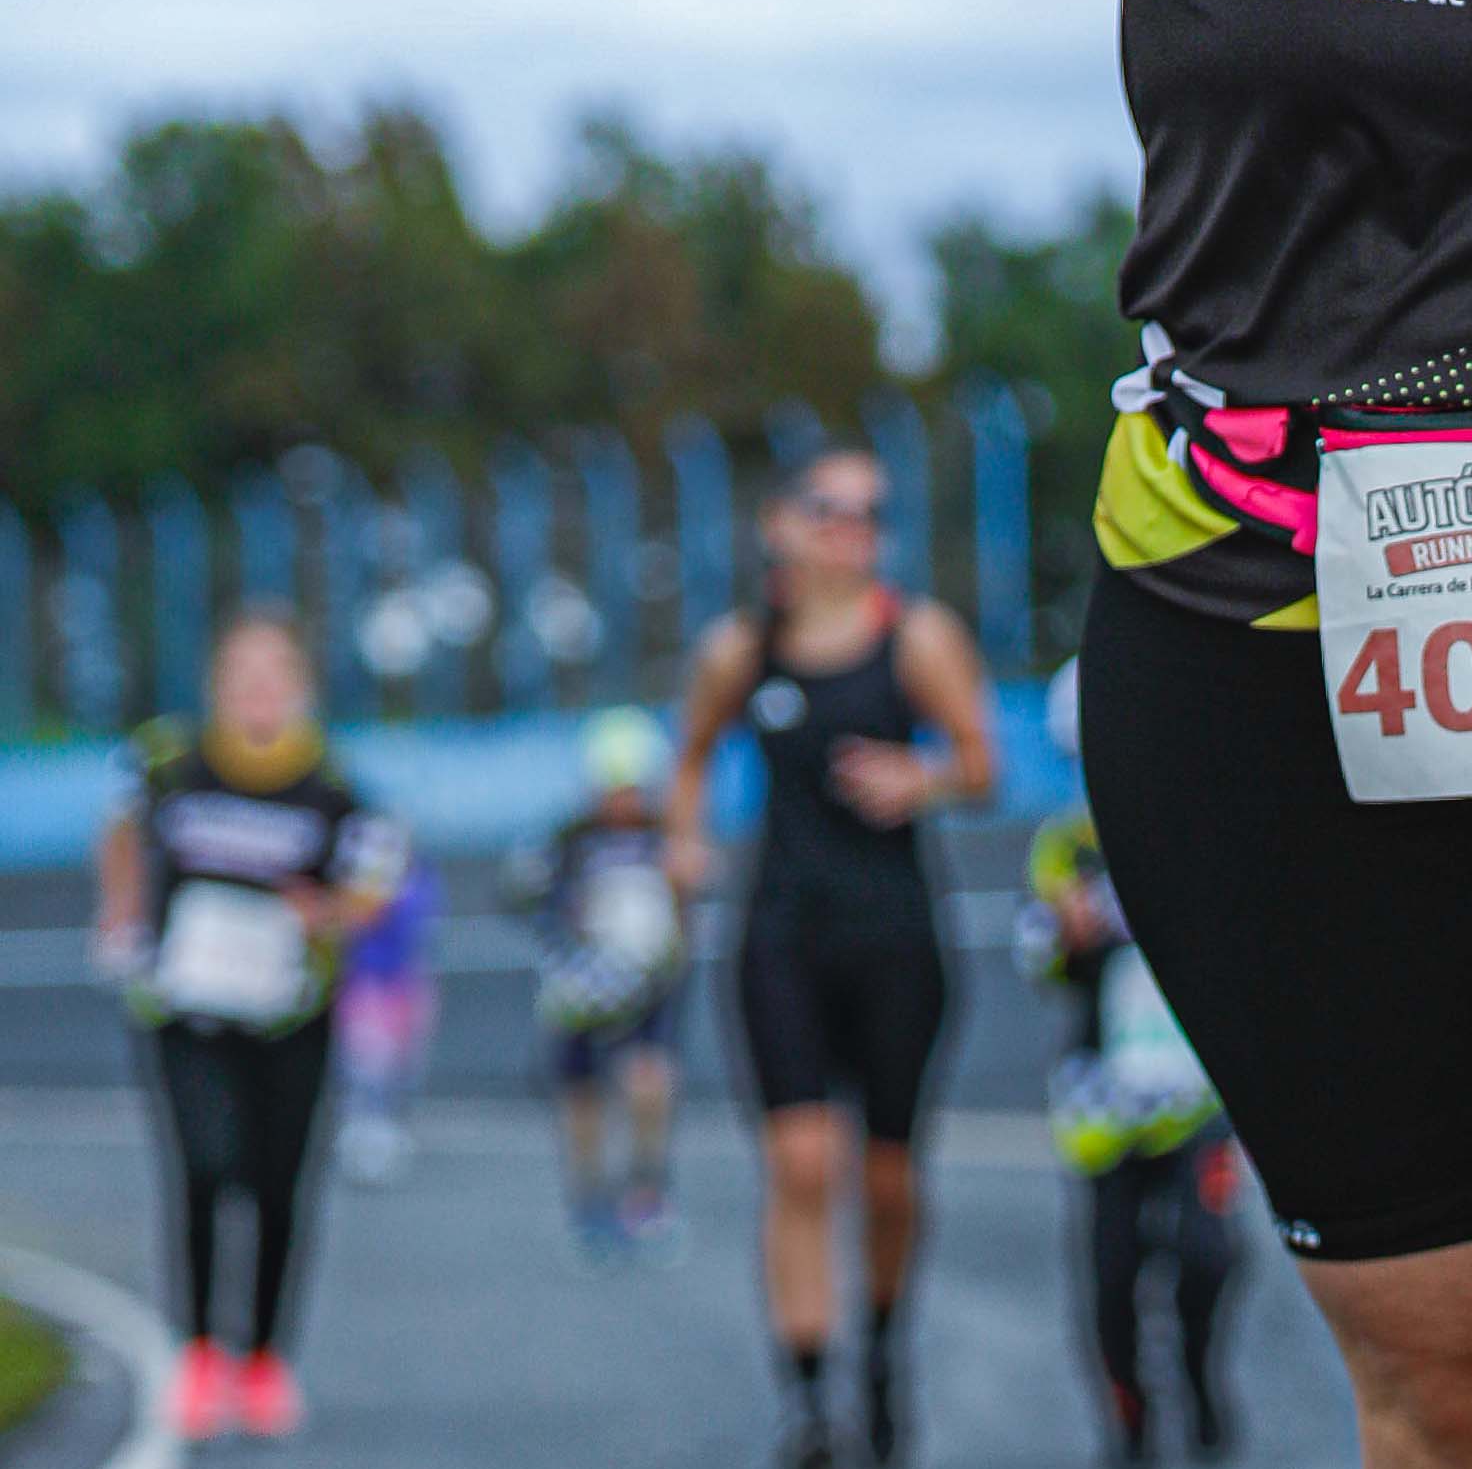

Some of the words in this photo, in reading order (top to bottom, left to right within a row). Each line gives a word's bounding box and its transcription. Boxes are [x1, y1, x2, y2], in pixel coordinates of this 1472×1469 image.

[1366, 584, 1383, 600] La
[1387, 581, 1443, 598] Carrera
[1447, 577, 1467, 593] de
